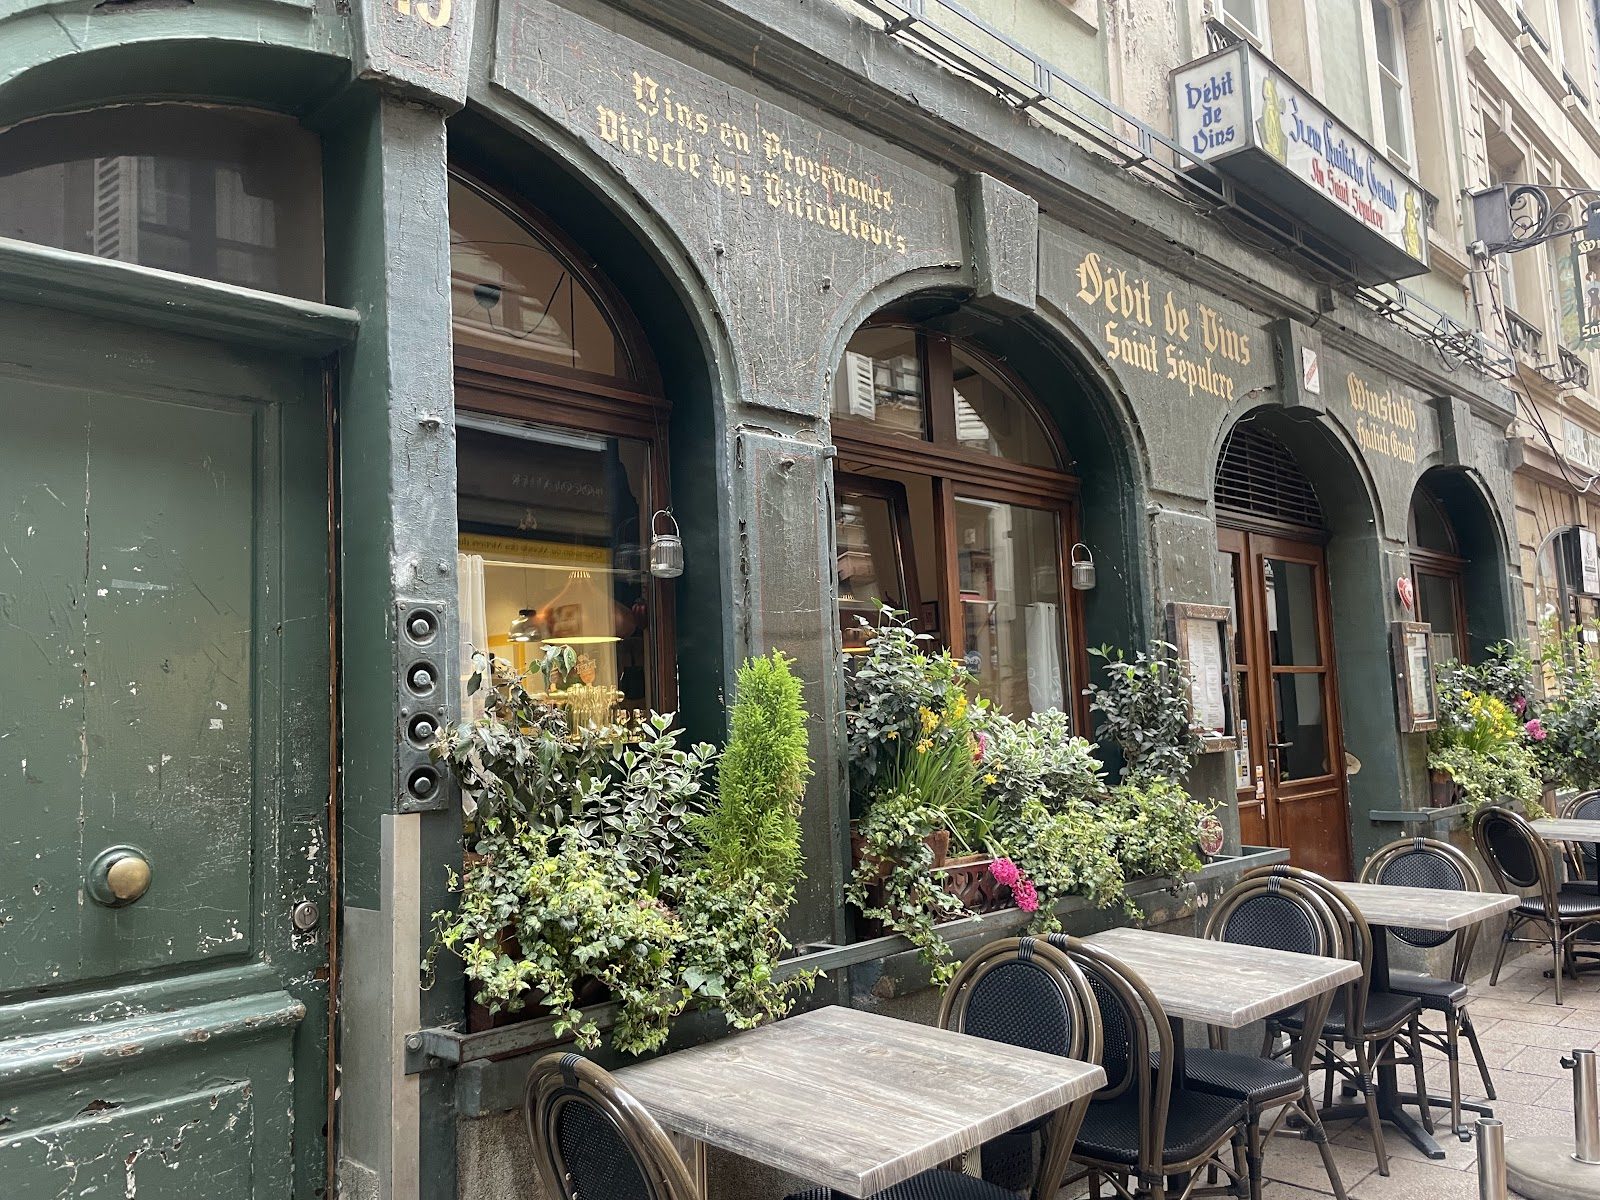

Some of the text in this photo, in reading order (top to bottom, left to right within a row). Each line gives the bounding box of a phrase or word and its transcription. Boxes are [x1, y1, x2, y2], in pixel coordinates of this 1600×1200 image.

[1185, 71, 1234, 109] Débit
[1193, 125, 1235, 154] Vins
[1202, 104, 1222, 127] de
[632, 71, 894, 214] Vins en Provenance
[596, 104, 906, 254] Directe des Viticulteurs
[1327, 169, 1350, 207] Saint
[1075, 252, 1250, 366] Débit de Vins
[1105, 320, 1234, 401] Saint Sépulcre
[1347, 371, 1416, 433] Winstubb
[1390, 430, 1416, 465] Graab
